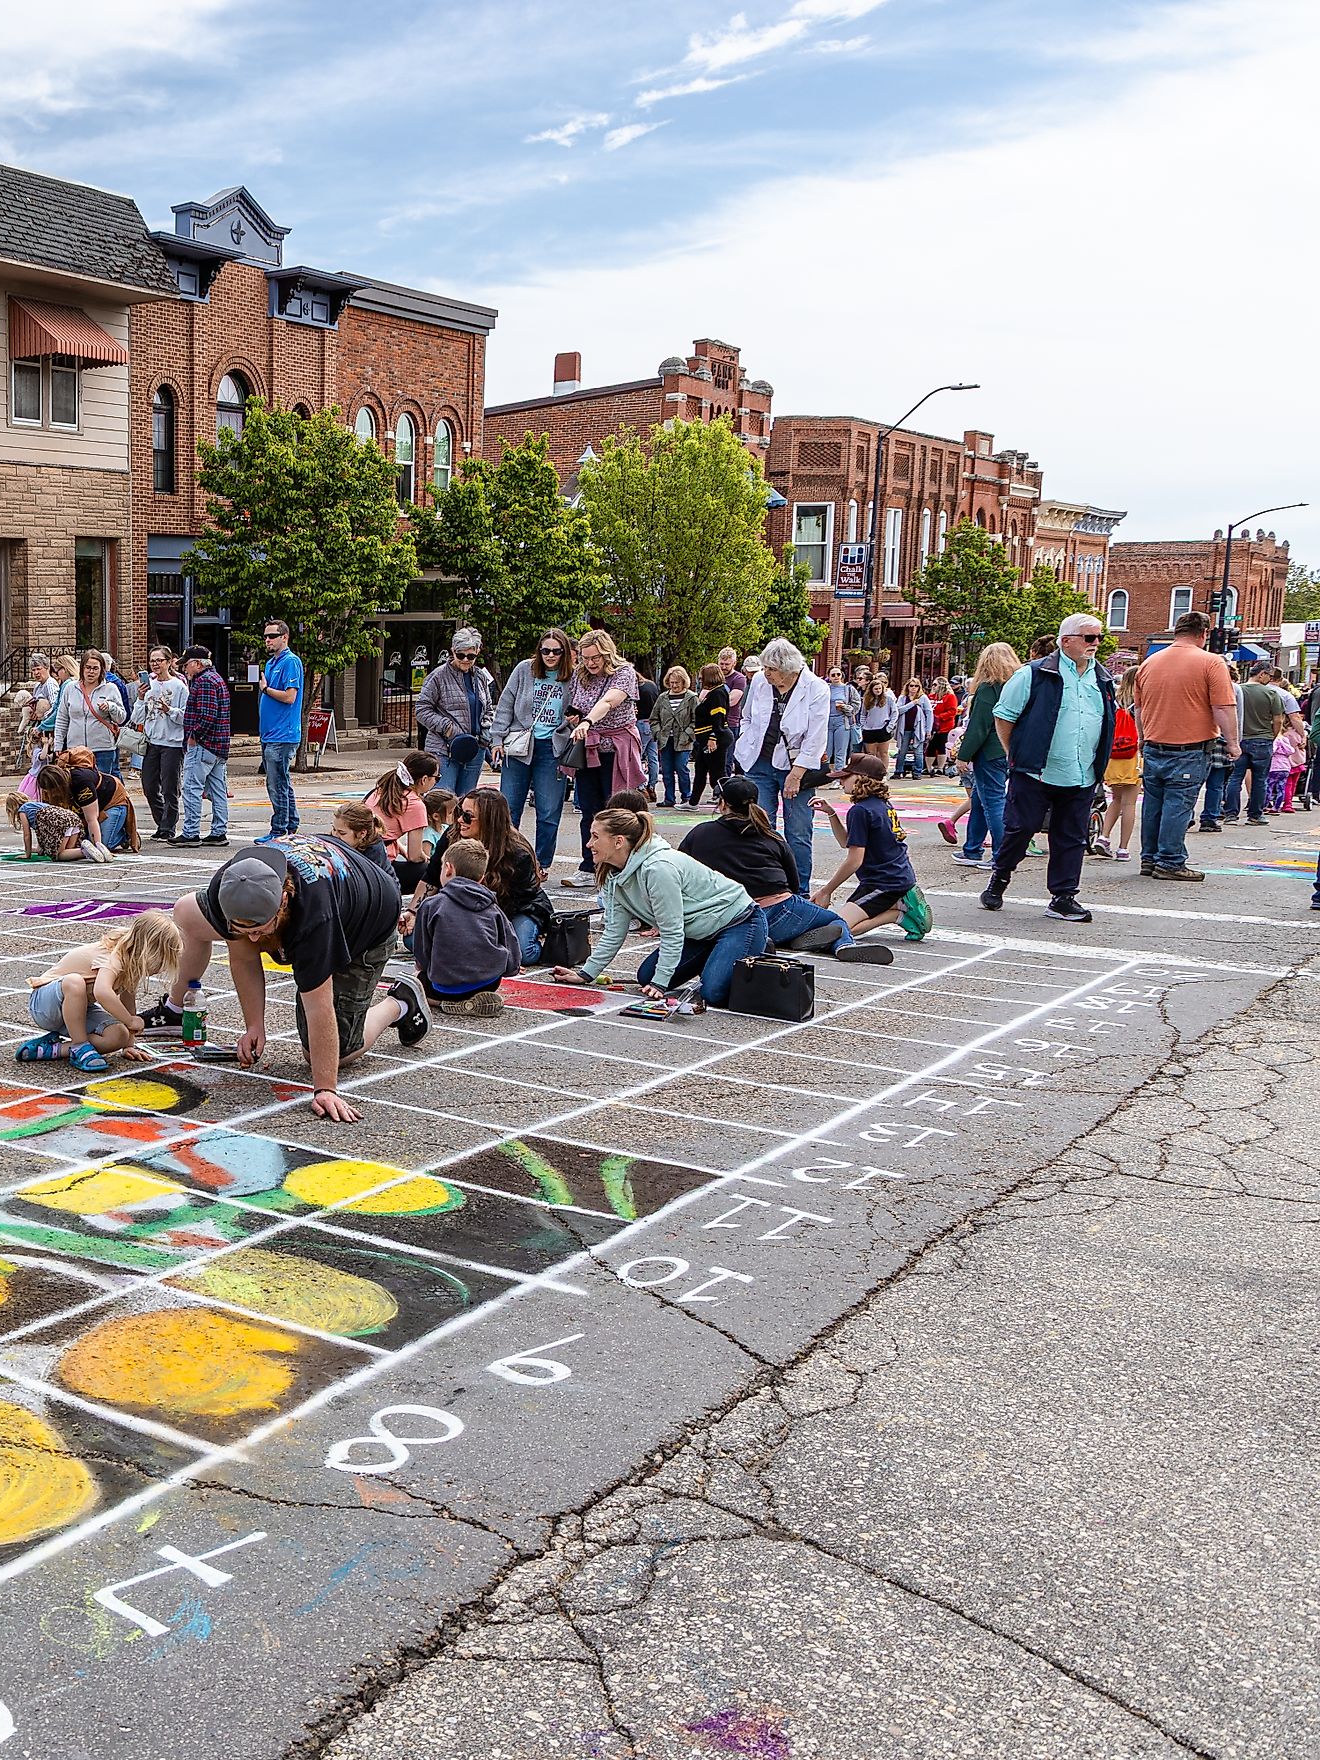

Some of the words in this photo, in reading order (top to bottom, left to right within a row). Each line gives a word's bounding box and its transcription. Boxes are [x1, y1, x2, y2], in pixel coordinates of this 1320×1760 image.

[541, 684, 563, 693] GREA
[1101, 982, 1177, 998] 19
[1072, 995, 1153, 1014] 18
[1044, 1016, 1127, 1034] 17
[1013, 1038, 1095, 1059] 16
[966, 1062, 1054, 1086] 15
[903, 1089, 1025, 1116] 14
[859, 1122, 959, 1149] 13
[791, 1156, 906, 1190] 12
[616, 1255, 755, 1304] 10
[323, 1403, 466, 1474] 8
[92, 1531, 268, 1637] 7
